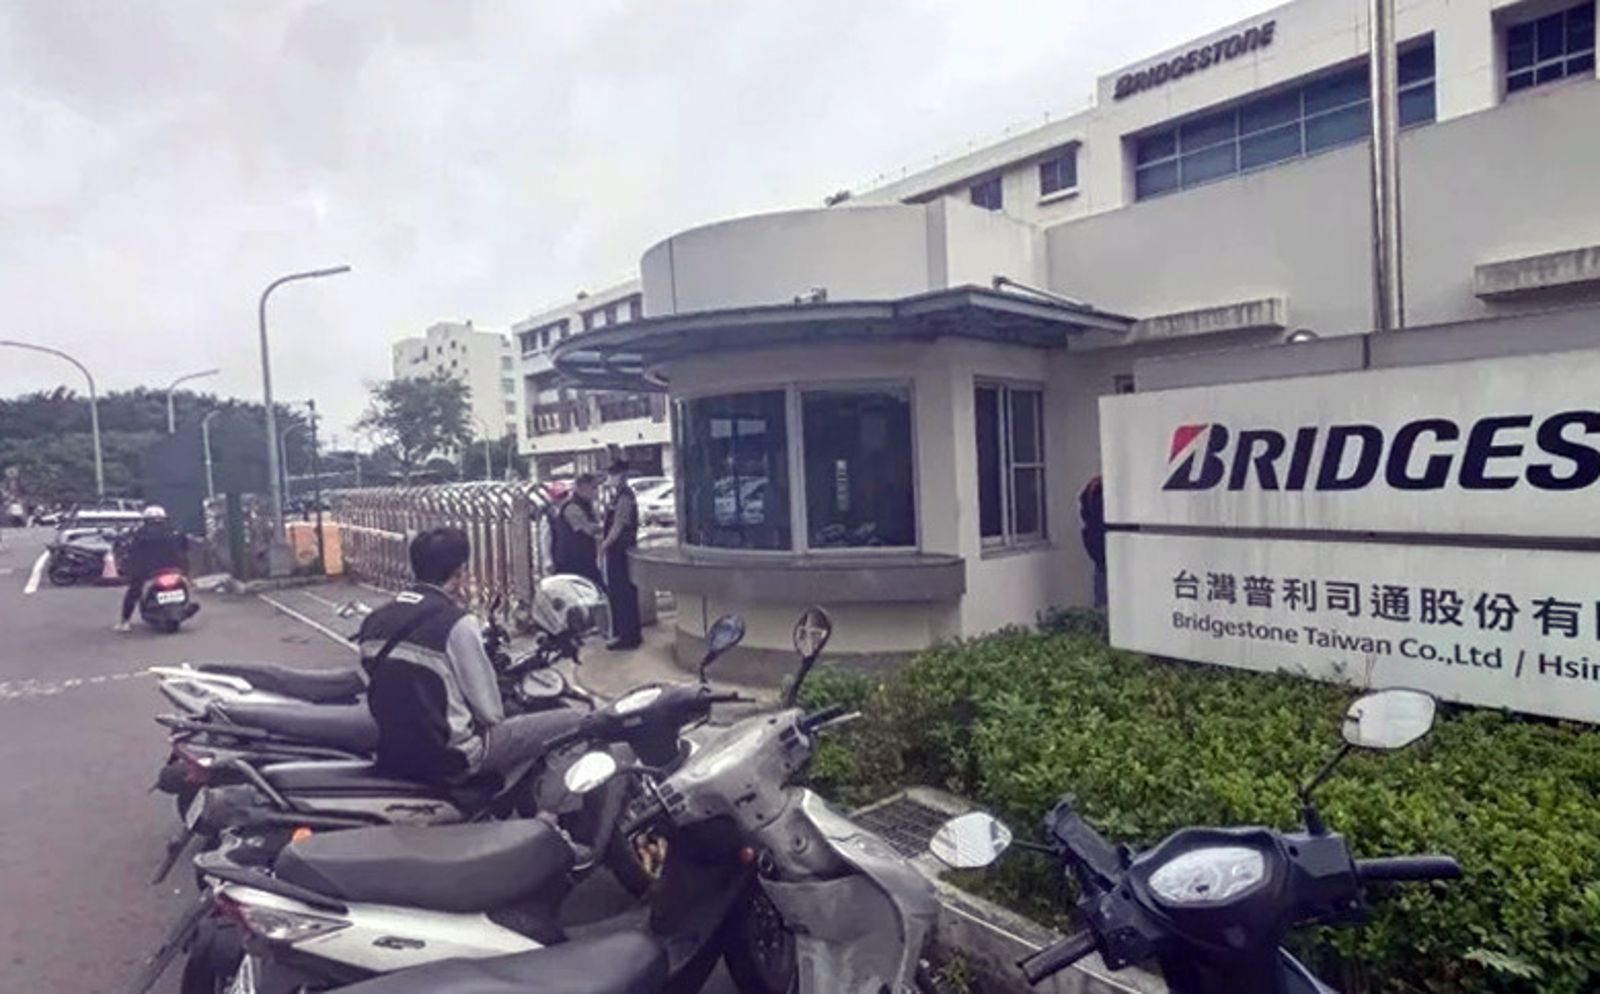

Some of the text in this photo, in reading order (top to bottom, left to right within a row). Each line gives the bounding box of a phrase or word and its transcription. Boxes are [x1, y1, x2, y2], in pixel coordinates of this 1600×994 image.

[1112, 19, 1276, 101] BRIDGESTONE
[1162, 409, 1600, 492] BRIDGES
[1172, 568, 1600, 641] 台灣普利司通股份有
[1172, 610, 1299, 644] Bridgestone
[1303, 625, 1392, 656] Taiwan
[1398, 637, 1503, 669] Co.,Ltd
